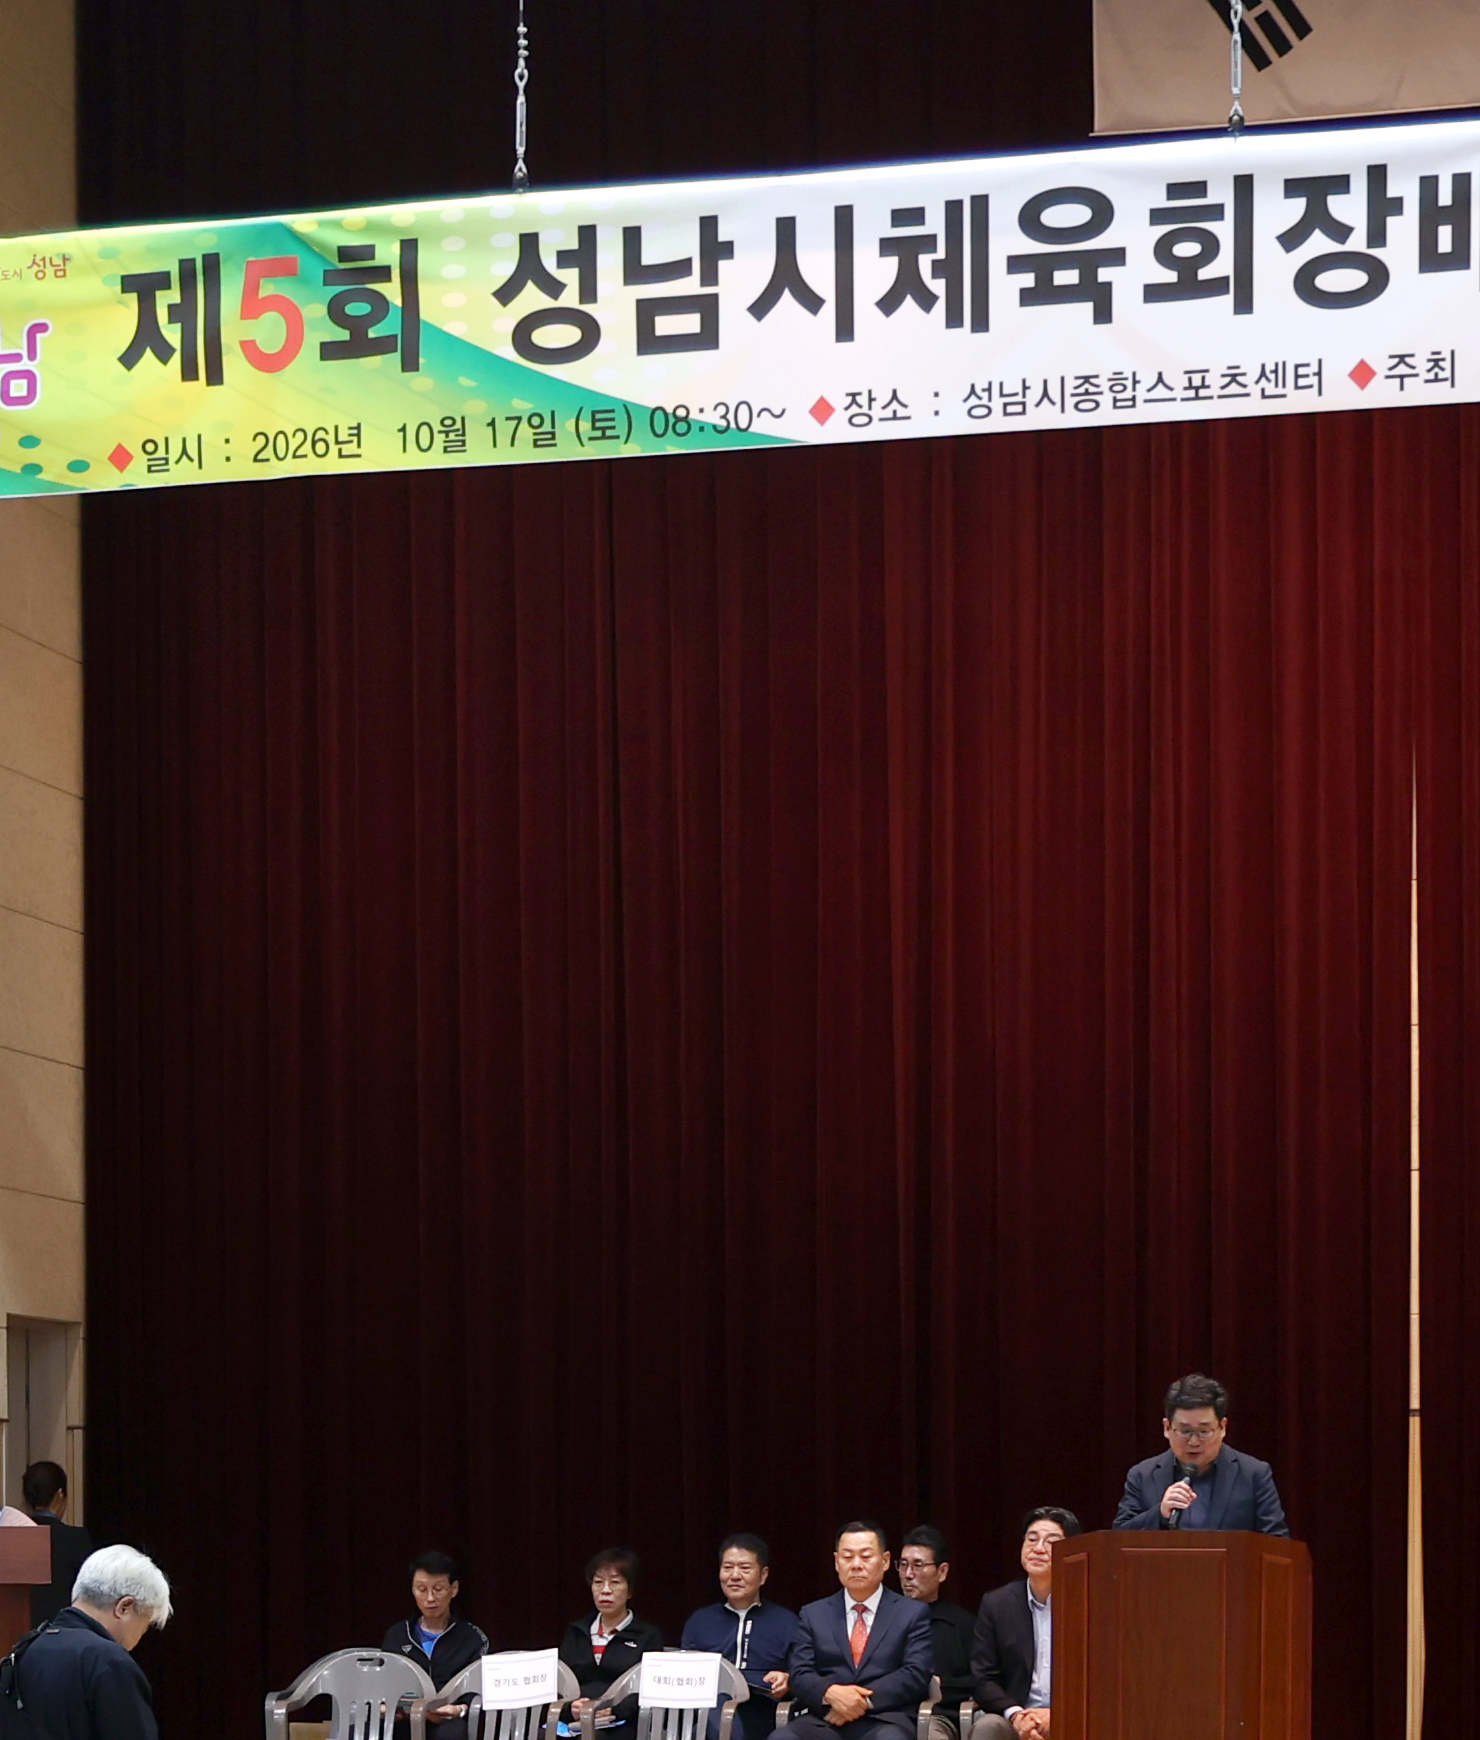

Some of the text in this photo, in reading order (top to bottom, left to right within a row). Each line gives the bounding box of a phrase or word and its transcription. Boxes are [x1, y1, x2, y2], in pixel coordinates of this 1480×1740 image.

[27, 253, 71, 281] 성남
[117, 237, 421, 387] 제5회
[141, 431, 205, 474] 일시
[251, 422, 364, 465] 2026년
[397, 415, 469, 455] 10월
[485, 408, 559, 449] 17일
[574, 401, 633, 447] (토)
[650, 400, 787, 441] 08:30~
[842, 388, 912, 431] 장소
[962, 358, 1324, 421] 성남시종합스포츠센터
[1384, 348, 1457, 392] 주최
[492, 1673, 547, 1687] 경기도 협회장
[652, 1674, 706, 1687] 대회(협회)장
